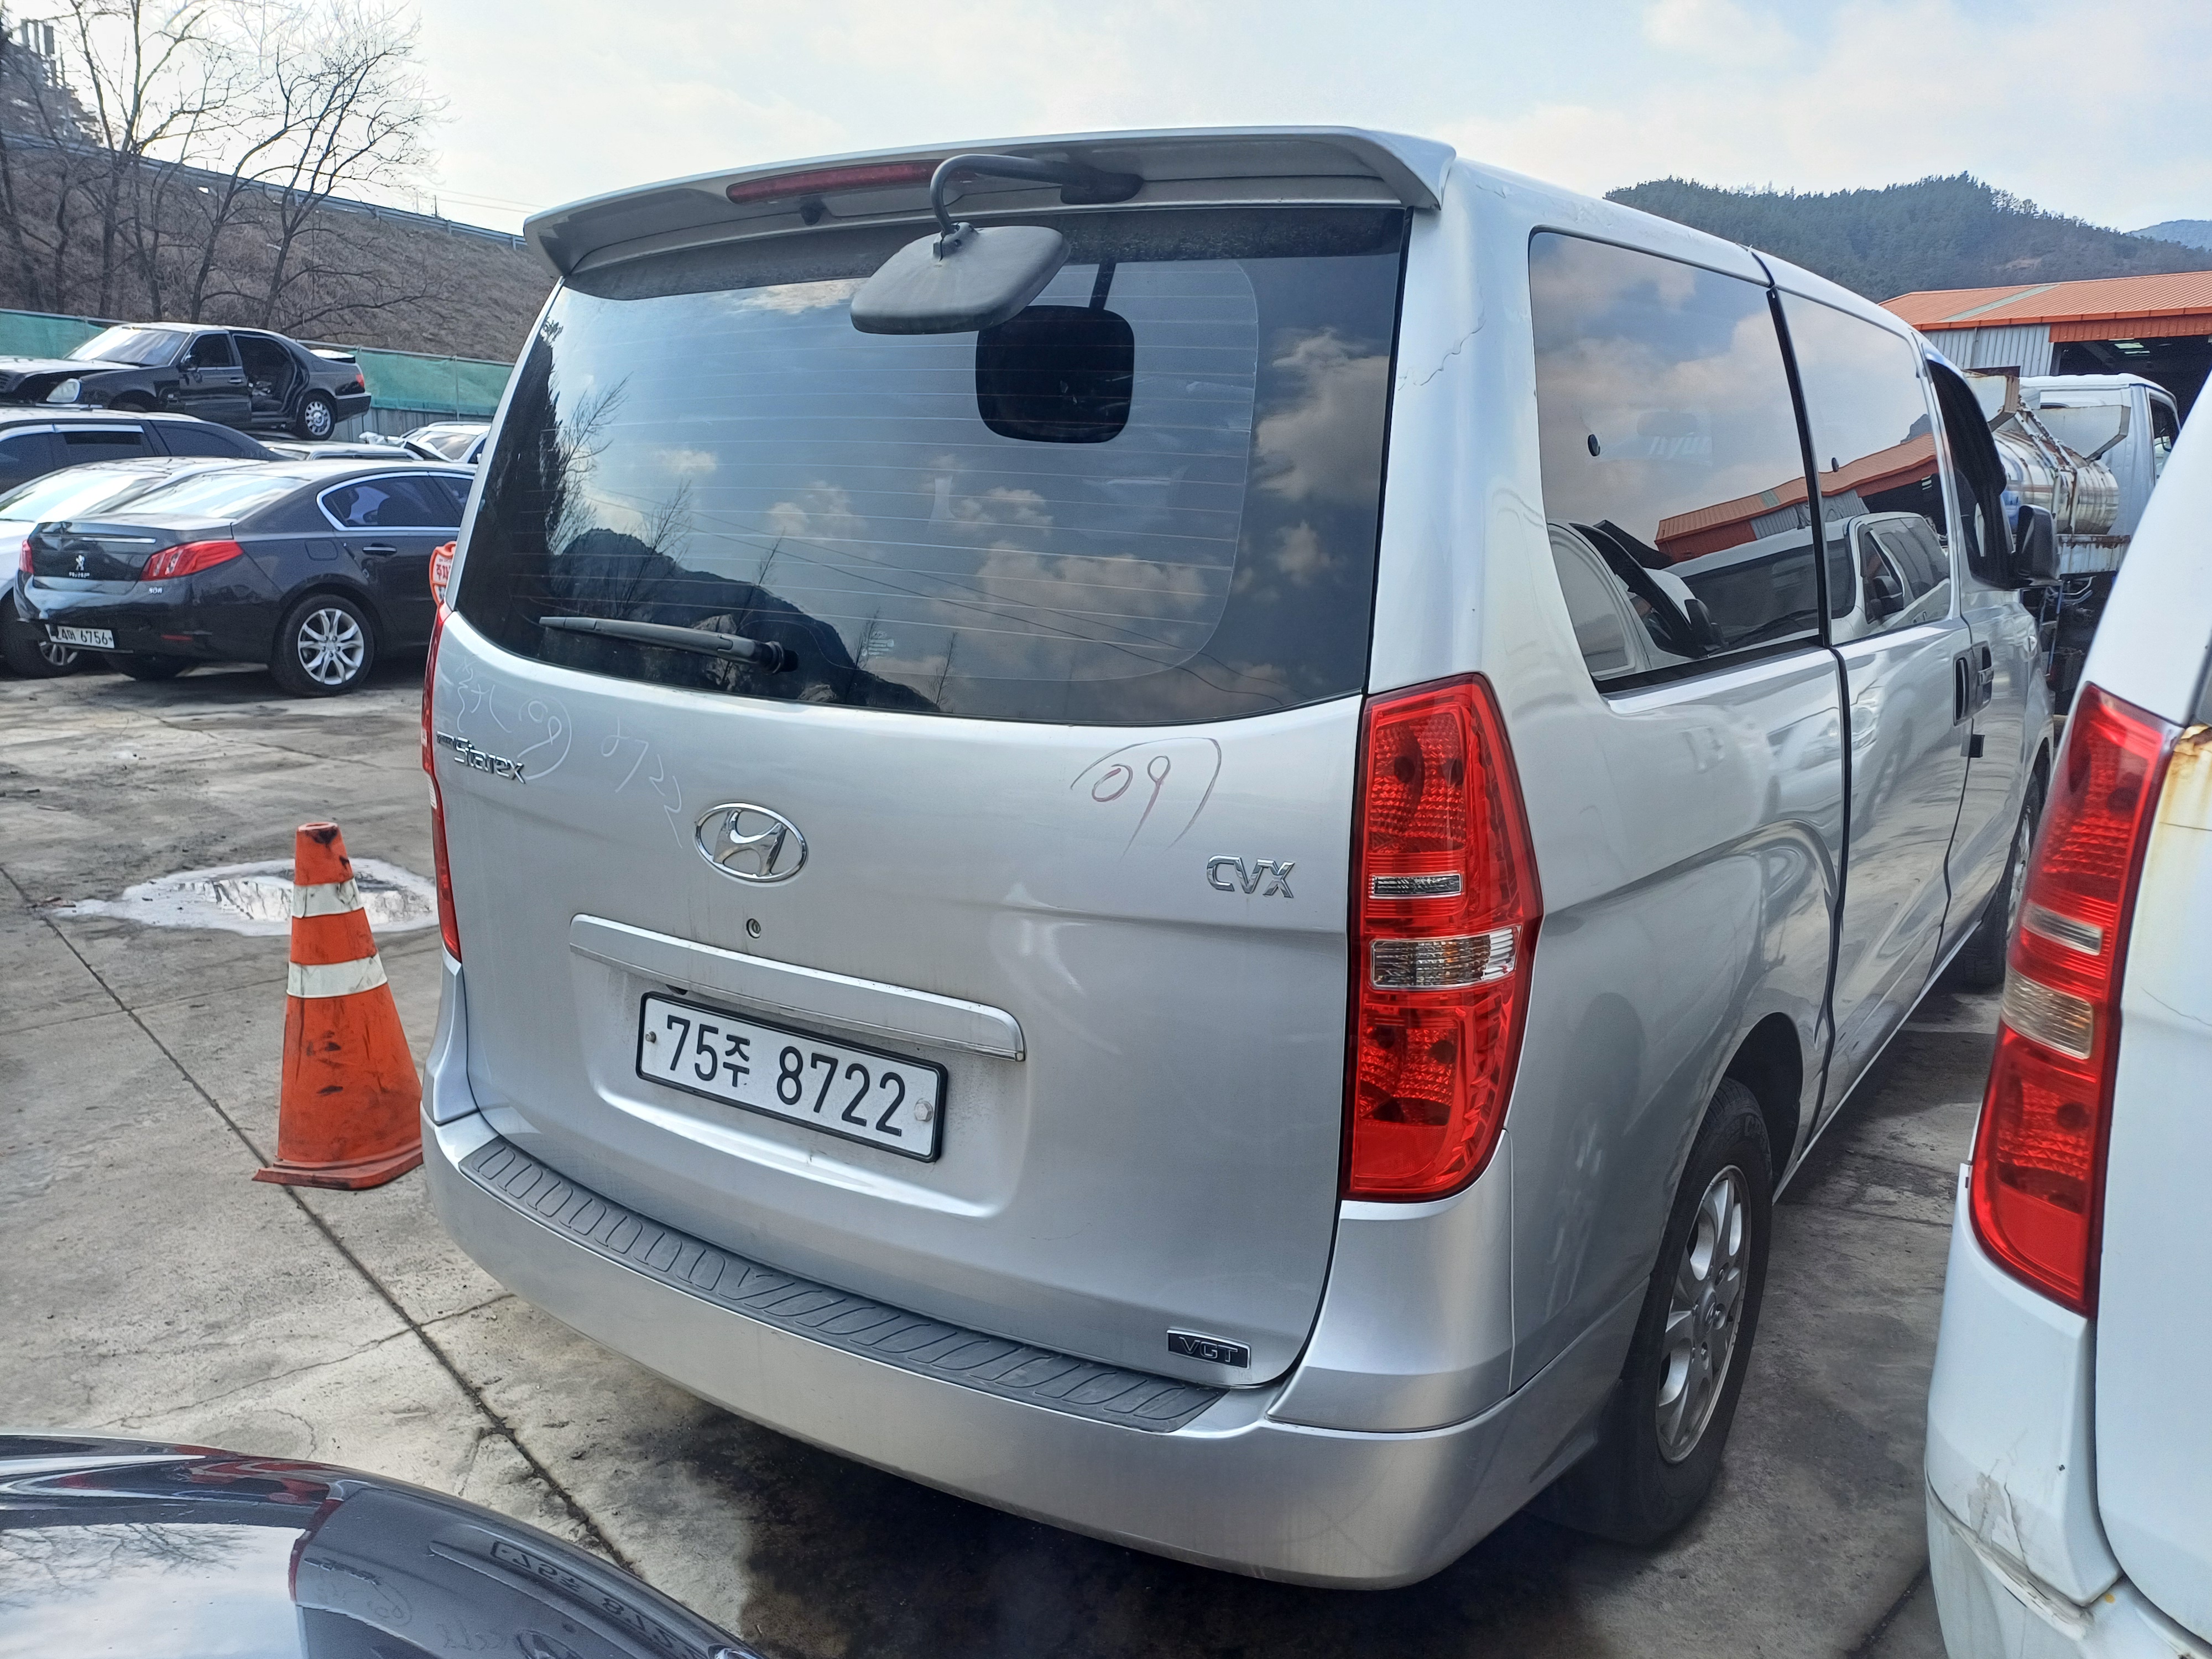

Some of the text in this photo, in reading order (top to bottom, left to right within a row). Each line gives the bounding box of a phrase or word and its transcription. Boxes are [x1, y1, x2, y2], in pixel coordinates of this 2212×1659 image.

[80, 630, 108, 645] 6756
[454, 736, 526, 784] Starex
[1206, 854, 1295, 899] CVX
[666, 1014, 906, 1137] 75주 8722
[1178, 1336, 1238, 1363] VGT
